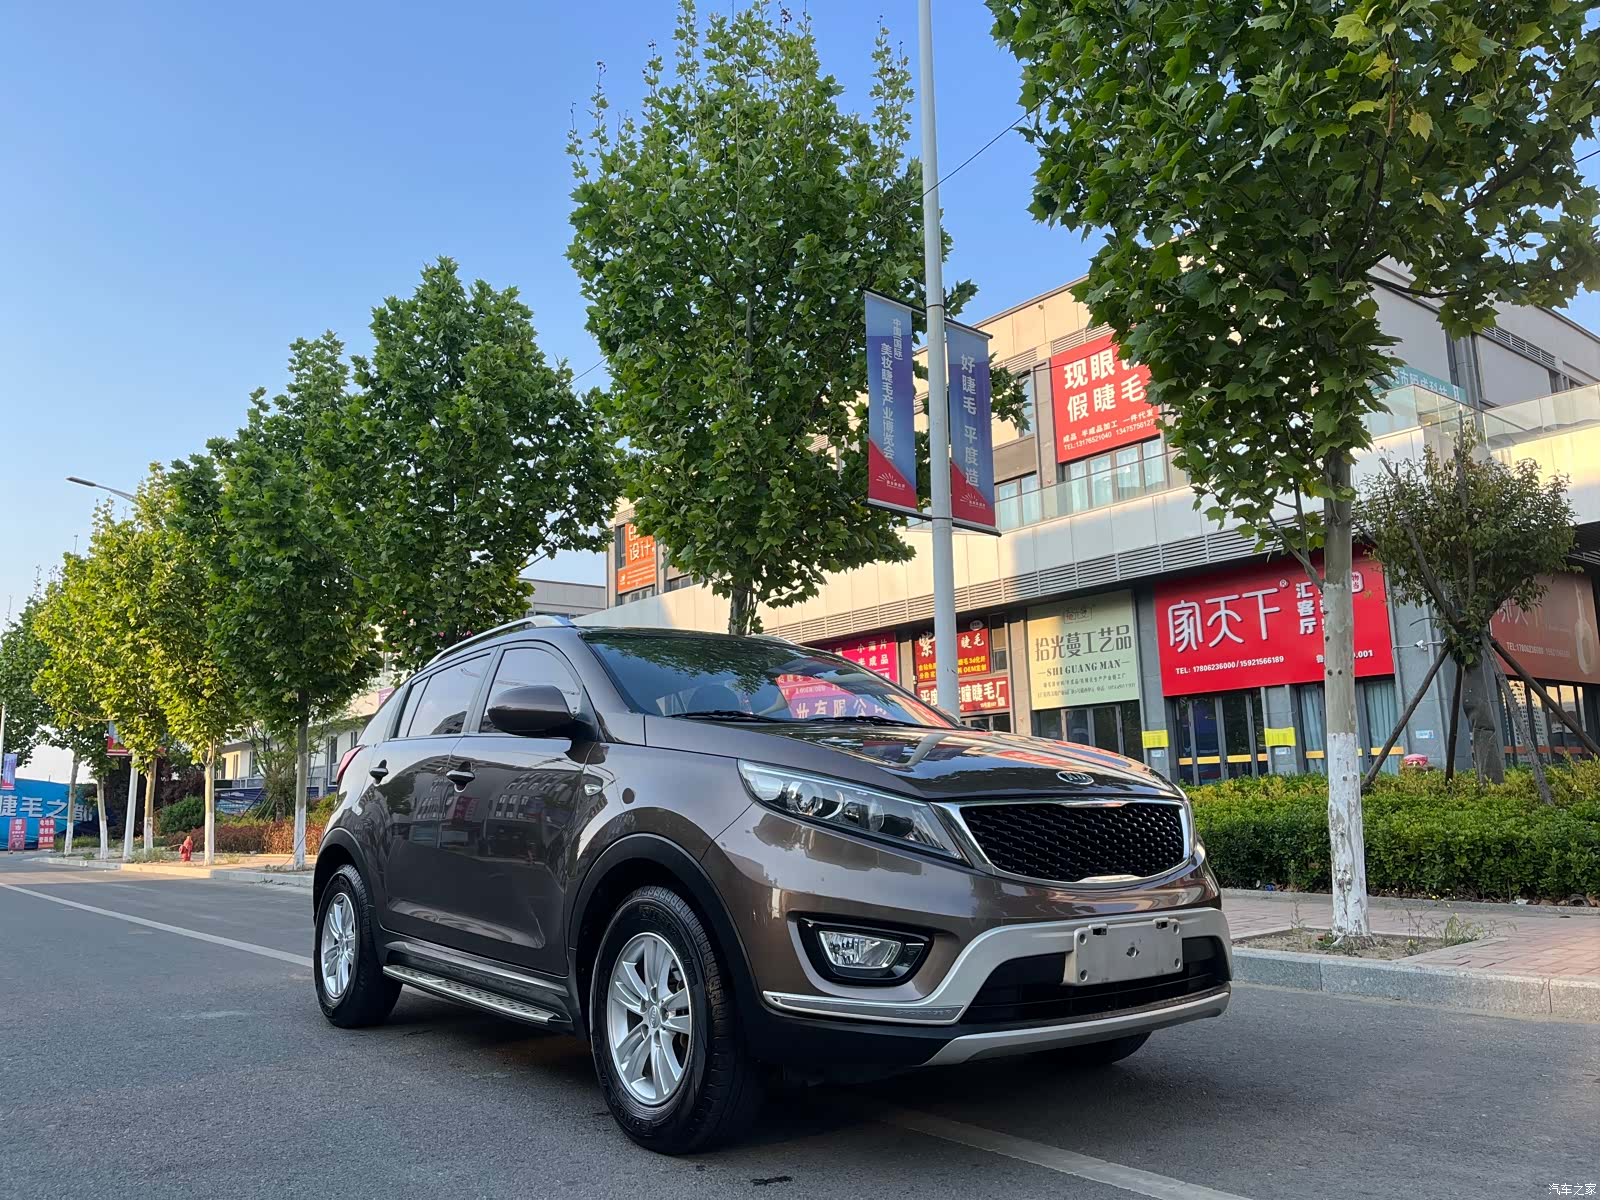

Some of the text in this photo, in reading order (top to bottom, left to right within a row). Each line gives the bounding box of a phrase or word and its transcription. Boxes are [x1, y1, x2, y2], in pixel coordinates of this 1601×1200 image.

[961, 354, 977, 415] 好睫毛
[1064, 348, 1140, 390] 现眼
[881, 342, 895, 460] 美妆睫毛产业博览会
[1066, 373, 1144, 423] 假睫毛
[964, 425, 980, 487] 平度造
[1062, 432, 1078, 443] 成品
[1082, 420, 1118, 437] 半成品加工
[1168, 588, 1280, 652] 家天下
[1296, 582, 1316, 634] 汇客厅
[1035, 624, 1132, 662] 拾光蔓工艺品
[1046, 659, 1121, 676] SHI GUANG MAN
